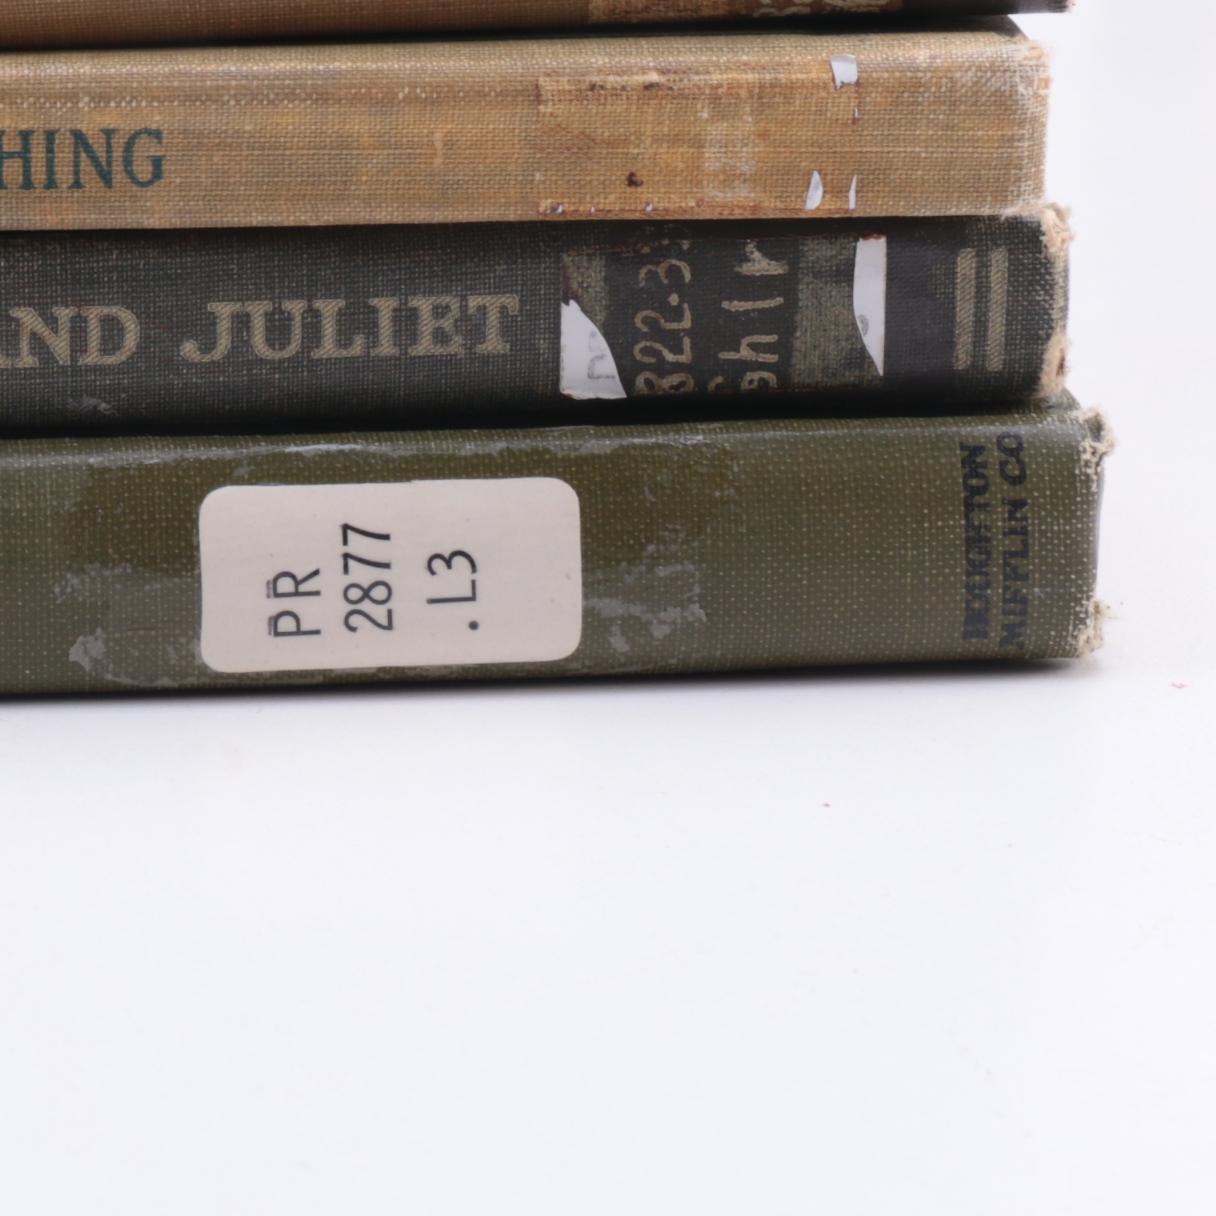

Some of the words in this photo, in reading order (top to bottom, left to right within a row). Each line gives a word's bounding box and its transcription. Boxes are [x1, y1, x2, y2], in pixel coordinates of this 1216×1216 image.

[180, 294, 522, 362] JULIET
[267, 567, 322, 637] PR
[340, 523, 394, 634] 2877
[426, 549, 480, 631] .L3
